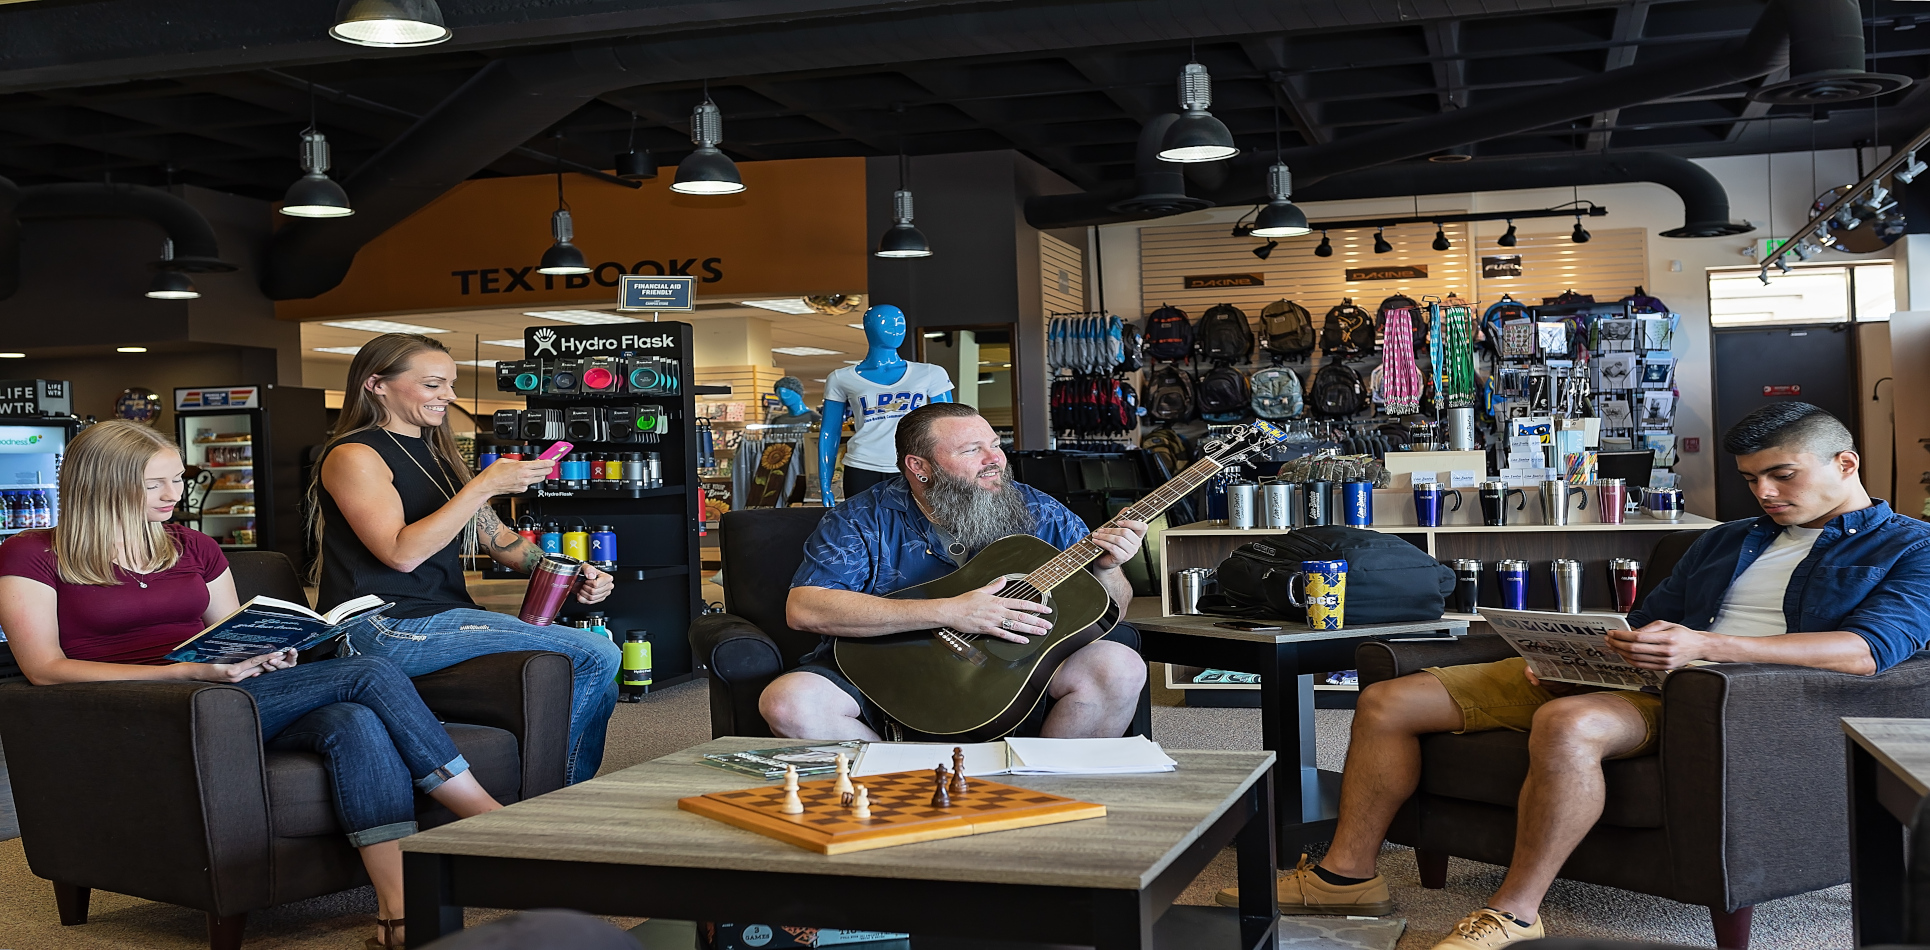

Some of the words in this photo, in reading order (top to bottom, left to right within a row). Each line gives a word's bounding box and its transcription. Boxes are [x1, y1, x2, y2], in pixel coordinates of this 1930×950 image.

[1352, 271, 1416, 280] DAKINE
[1191, 278, 1252, 287] DAKINE
[561, 337, 617, 355] Hydro
[621, 334, 675, 349] Flask
[0, 402, 34, 414] WTR
[1491, 618, 1612, 635] COMMUTE
[1585, 647, 1605, 657] to
